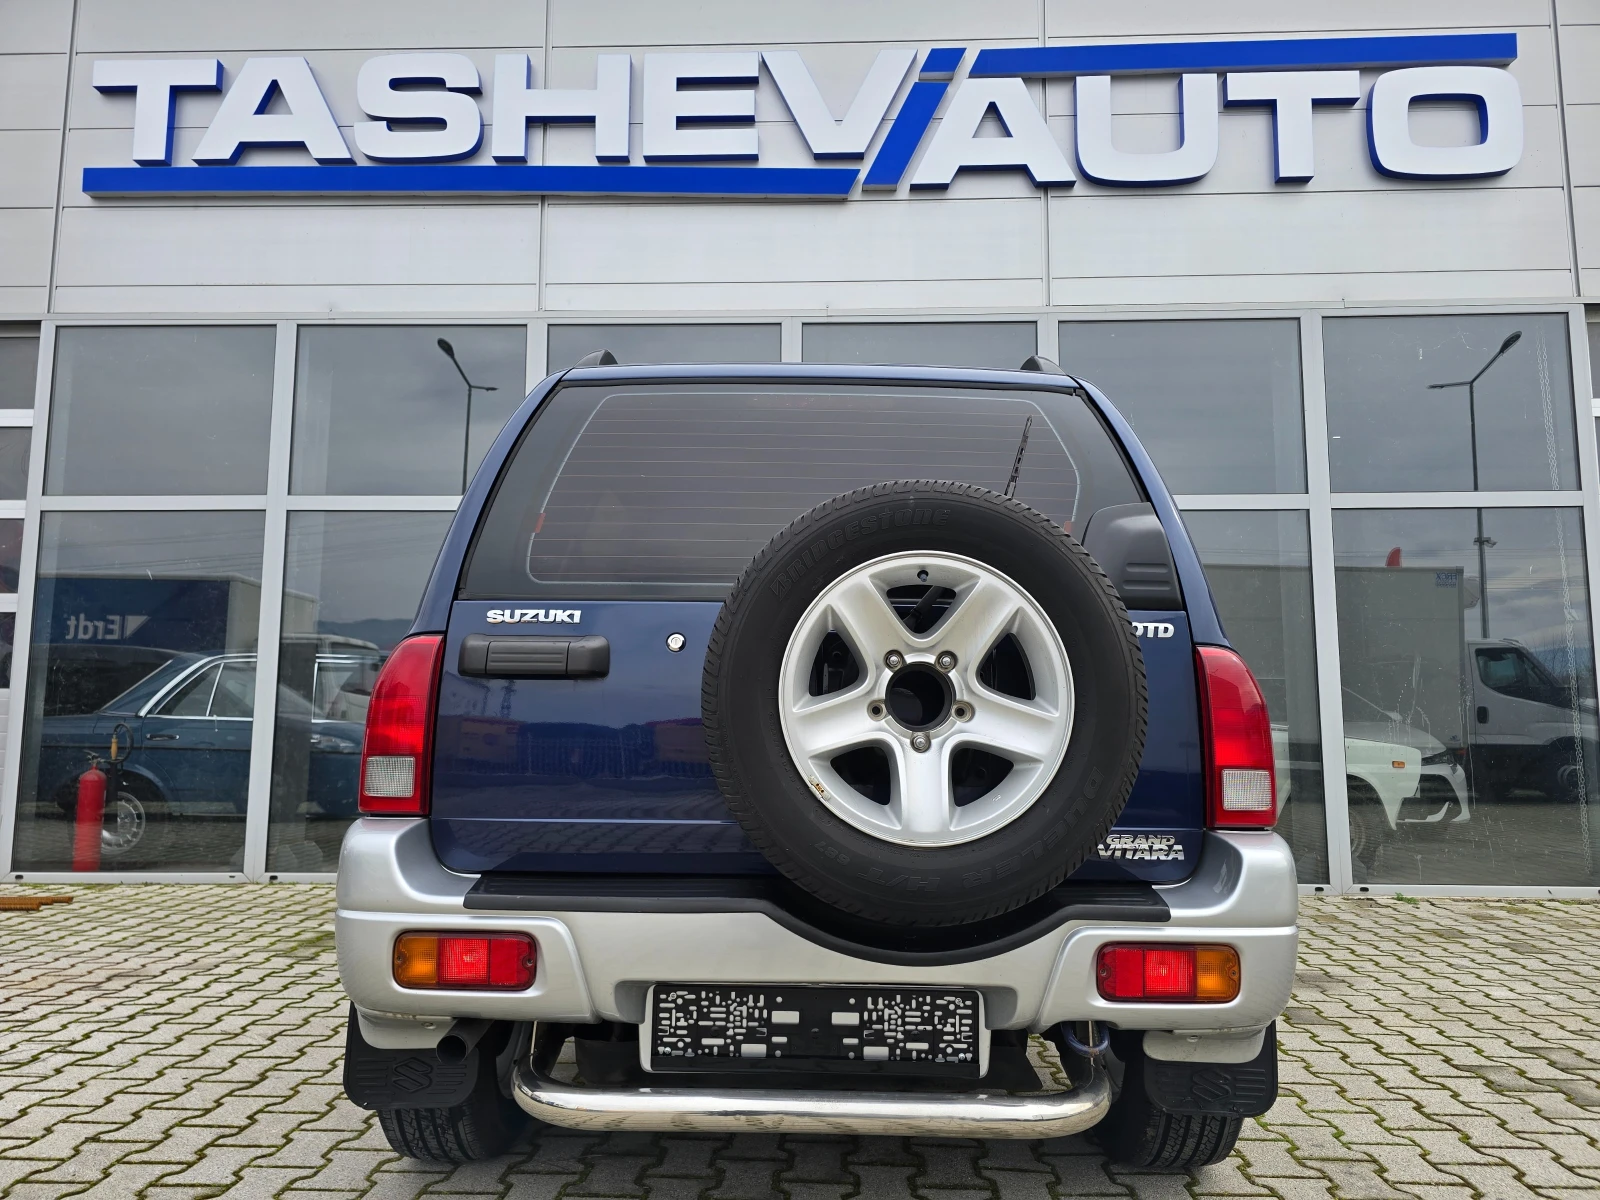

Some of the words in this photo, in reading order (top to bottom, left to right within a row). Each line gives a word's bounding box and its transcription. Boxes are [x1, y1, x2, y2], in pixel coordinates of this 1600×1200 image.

[92, 50, 918, 167] TASHEV
[910, 65, 1524, 188] AUTO
[769, 507, 951, 602] BRIDGESTONE
[486, 609, 582, 624] SUZUKI
[1105, 834, 1176, 846] GRAND
[1096, 843, 1185, 861] VITARA
